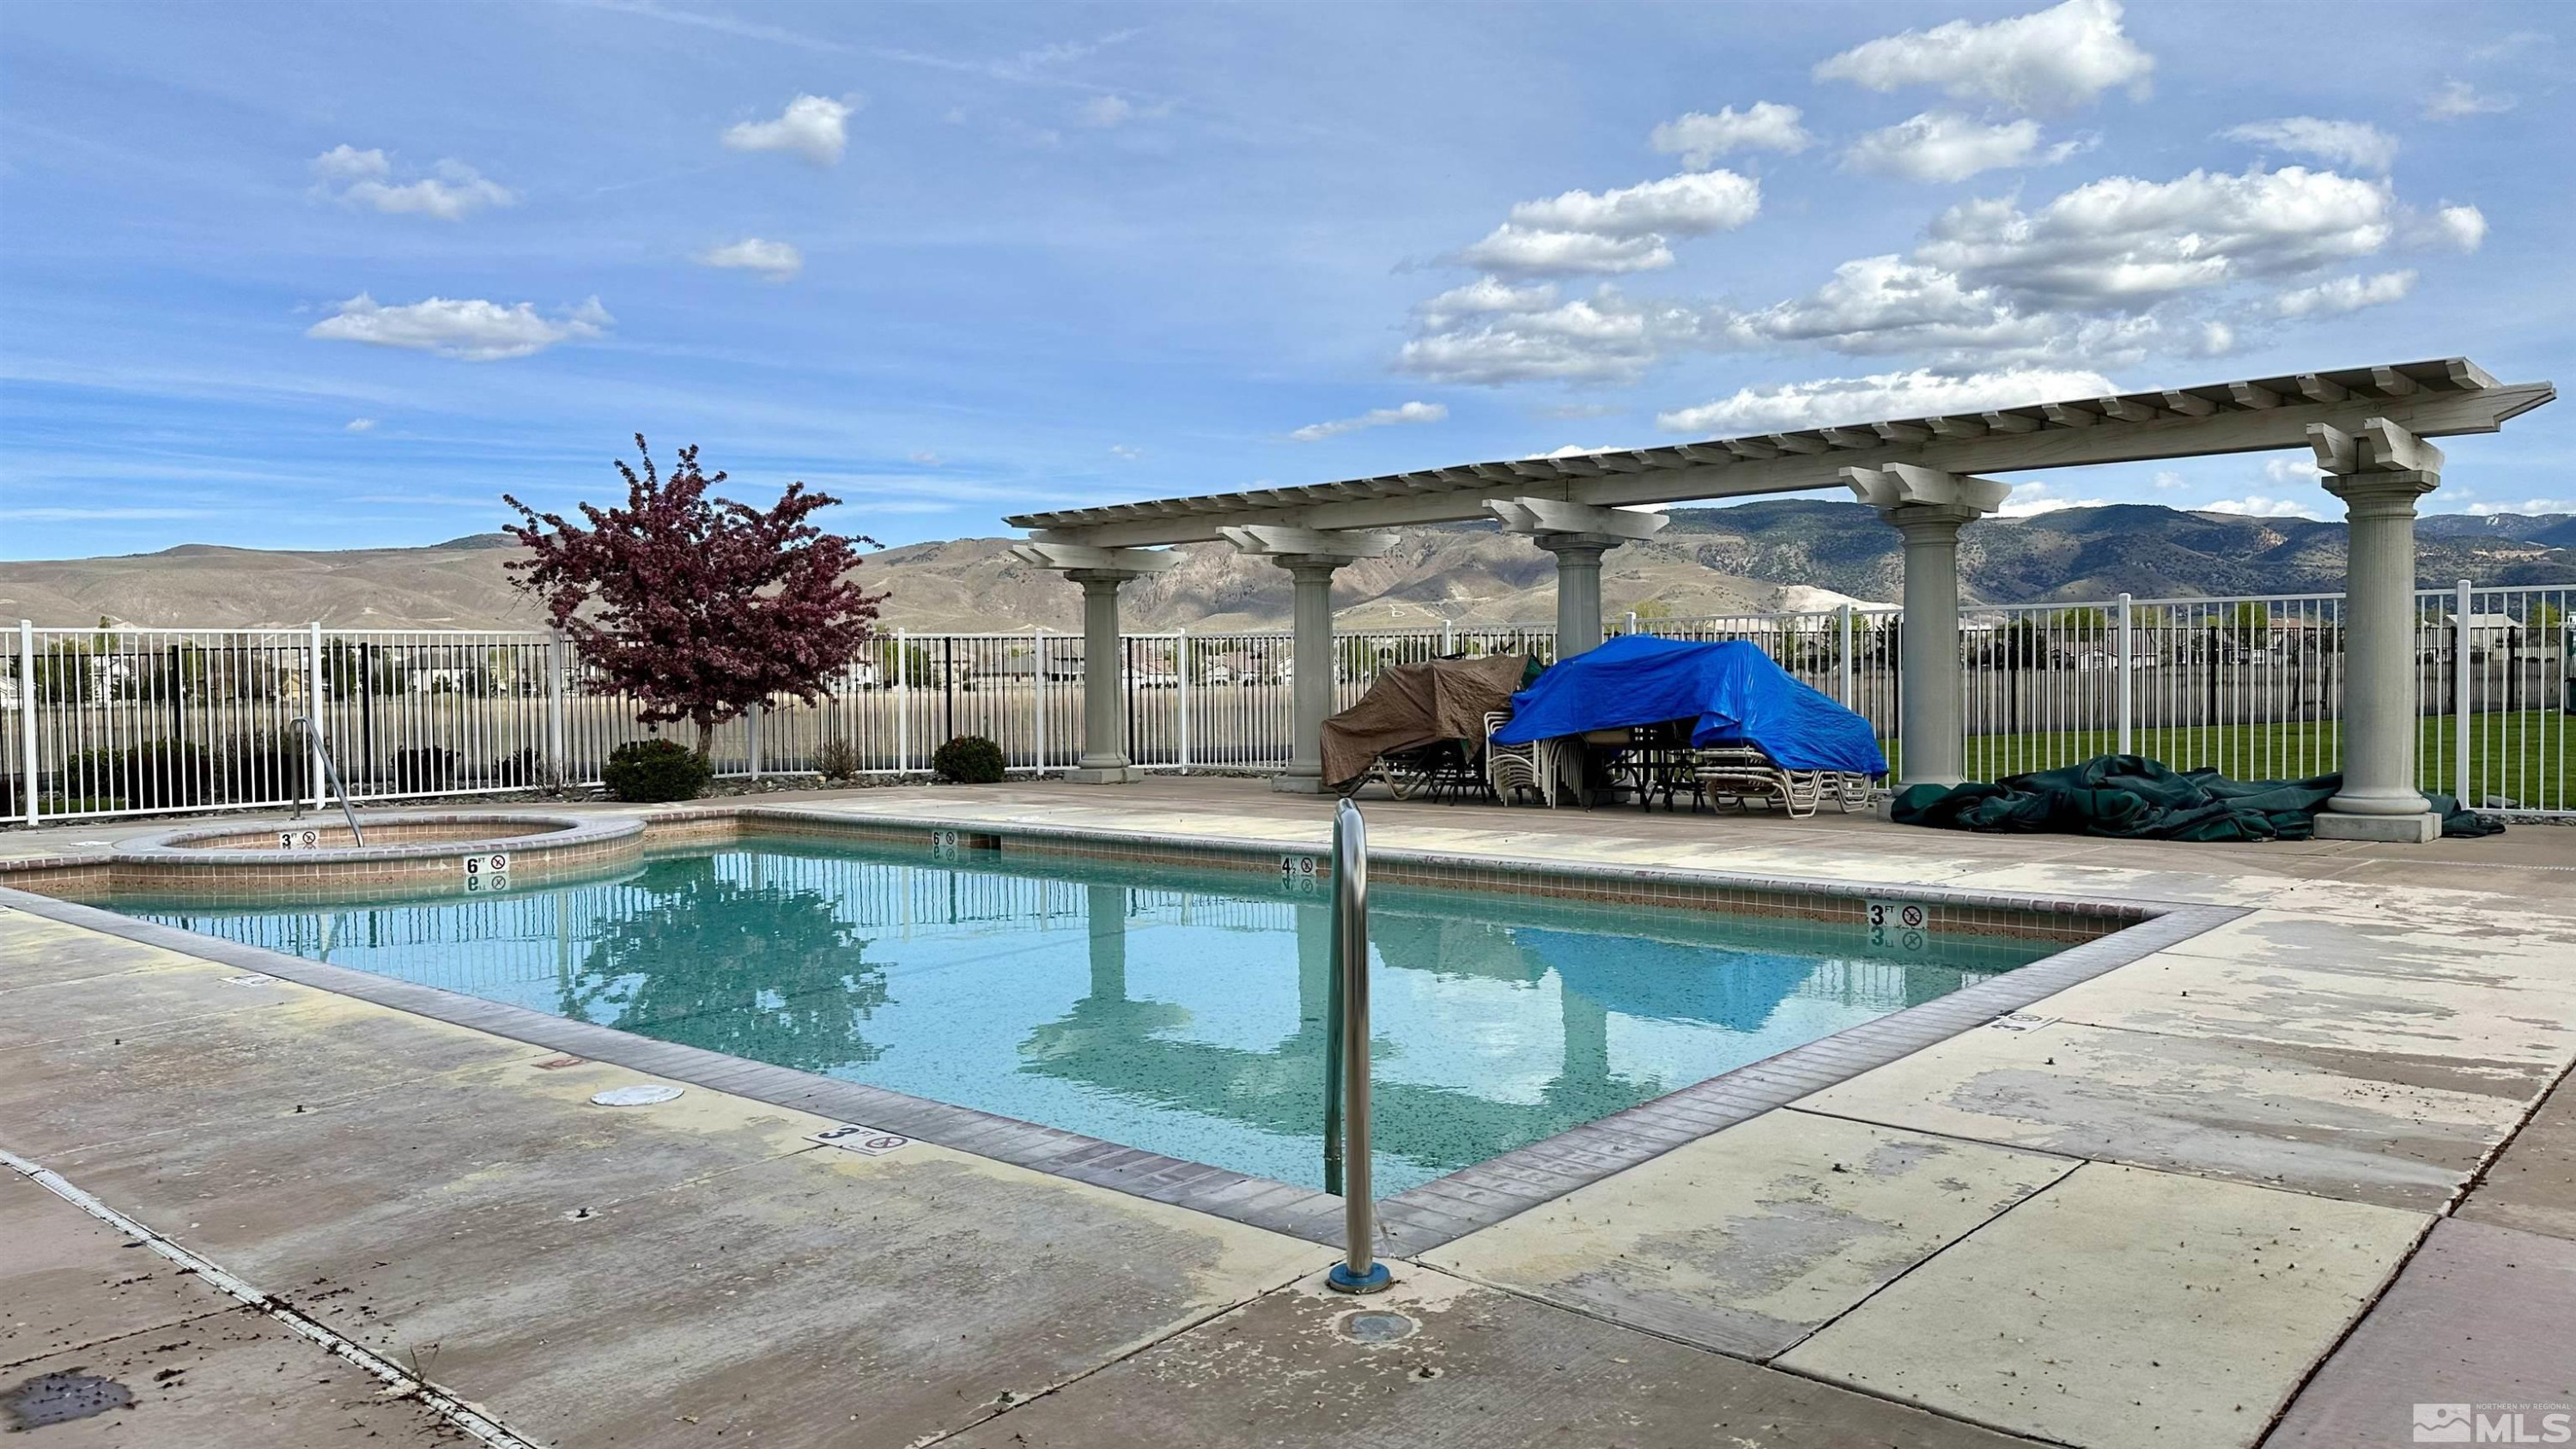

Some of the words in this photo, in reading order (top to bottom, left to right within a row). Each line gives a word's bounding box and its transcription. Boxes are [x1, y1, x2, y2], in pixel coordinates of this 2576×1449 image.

[282, 834, 291, 846] 3
[933, 832, 940, 845] 6
[467, 858, 478, 874] 6
[1871, 905, 1884, 925] 3
[817, 1127, 860, 1139] 3
